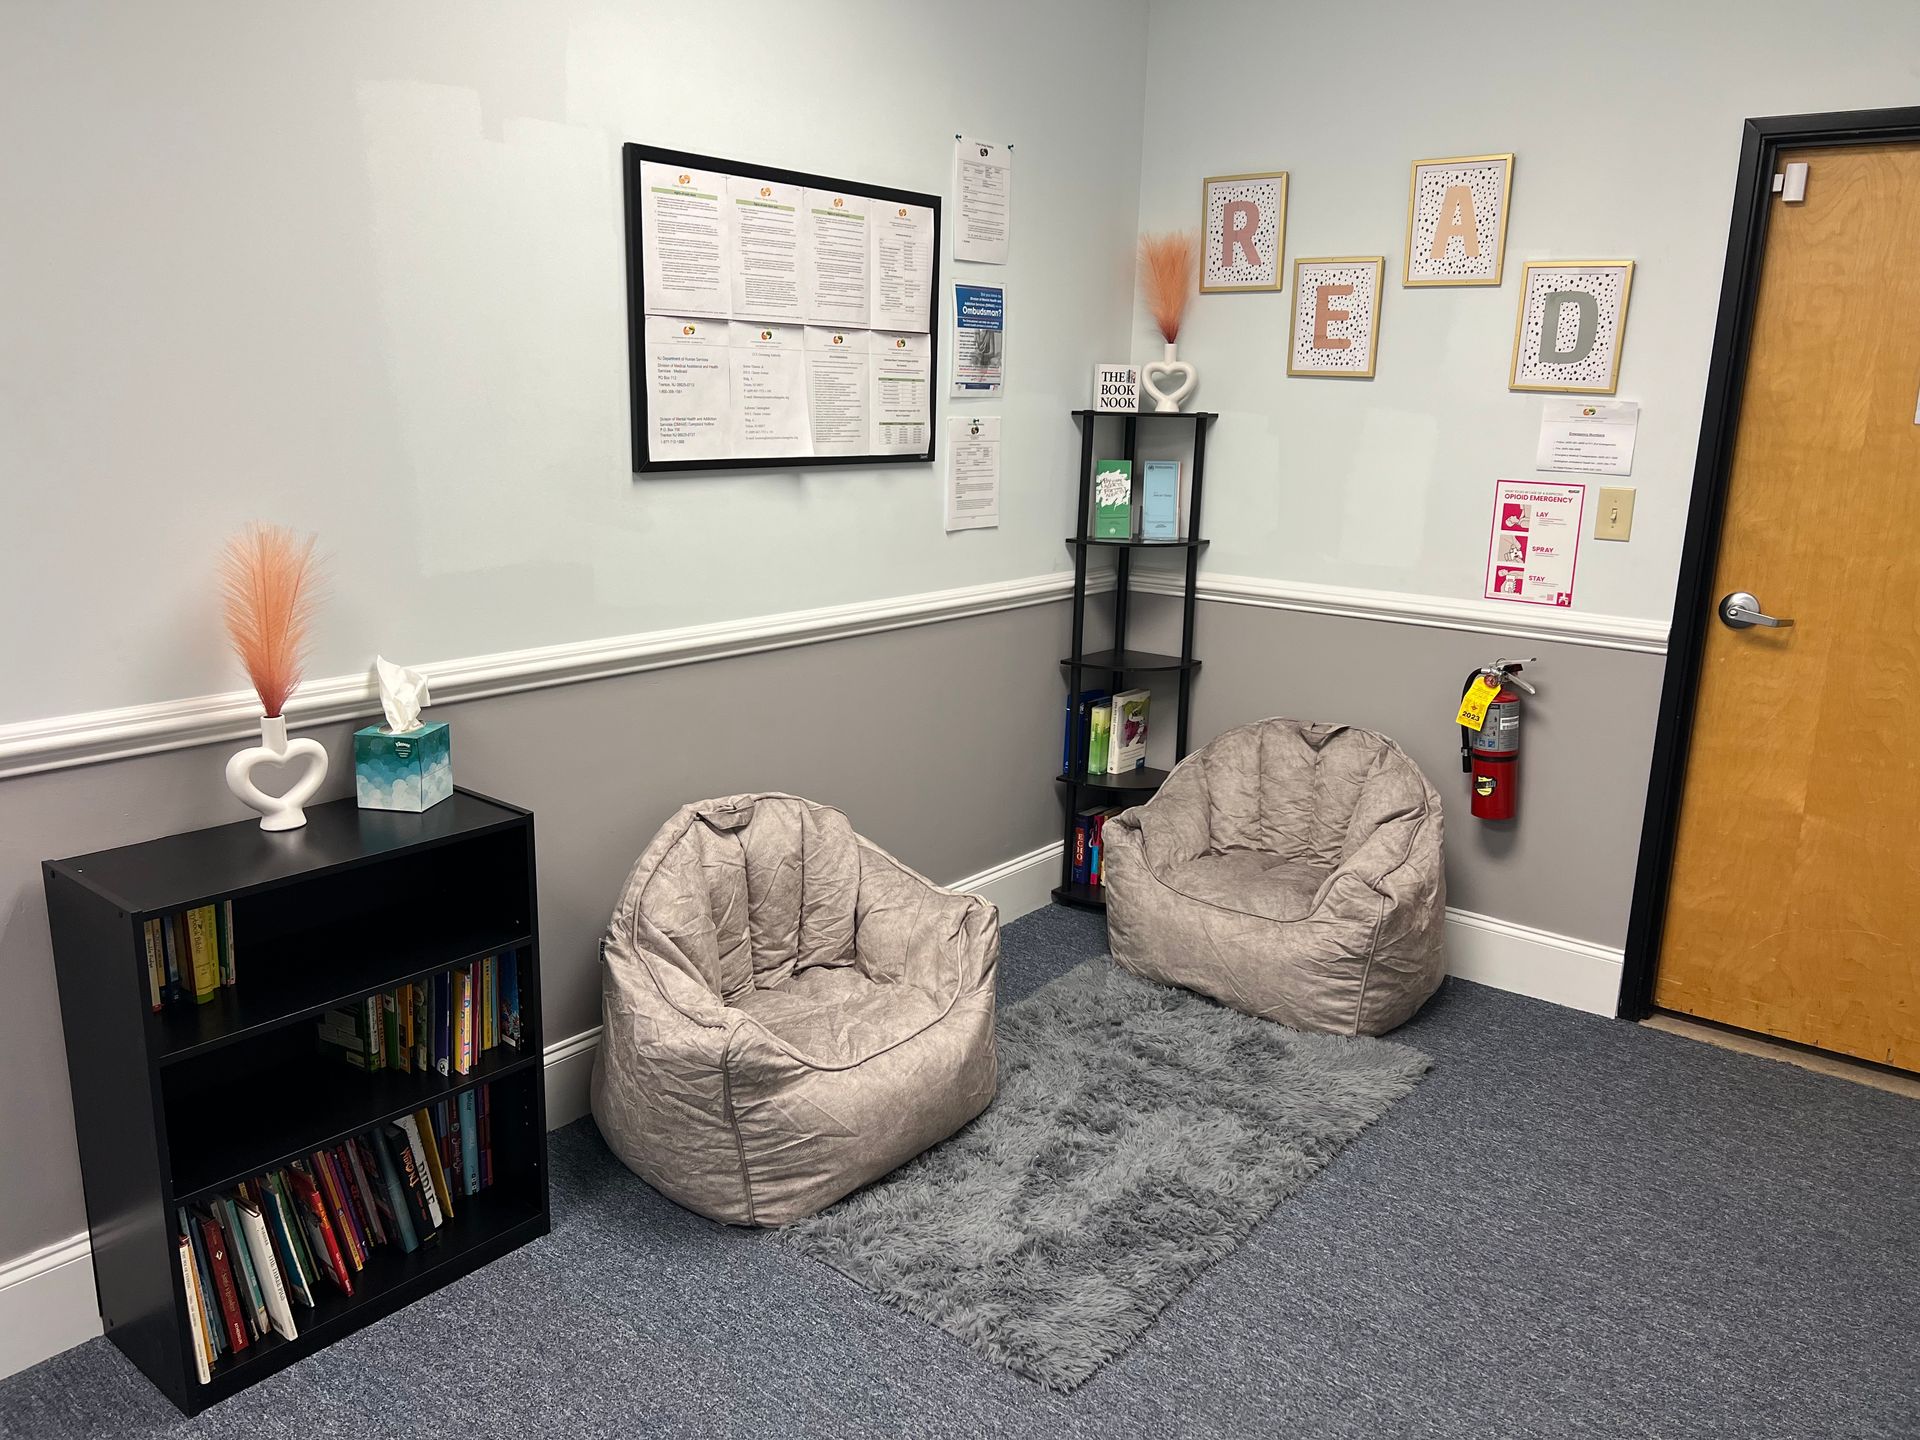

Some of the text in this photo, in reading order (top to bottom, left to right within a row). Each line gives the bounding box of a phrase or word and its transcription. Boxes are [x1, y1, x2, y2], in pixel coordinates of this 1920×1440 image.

[1221, 185, 1599, 364] R E A D
[962, 306, 1002, 317] Ombudsman?
[1101, 371, 1125, 383] THE
[1101, 384, 1135, 395] BOOK
[1100, 397, 1136, 409] NOOK
[1504, 493, 1573, 503] OPIOID EMERGENCY
[1462, 710, 1481, 722] 2023
